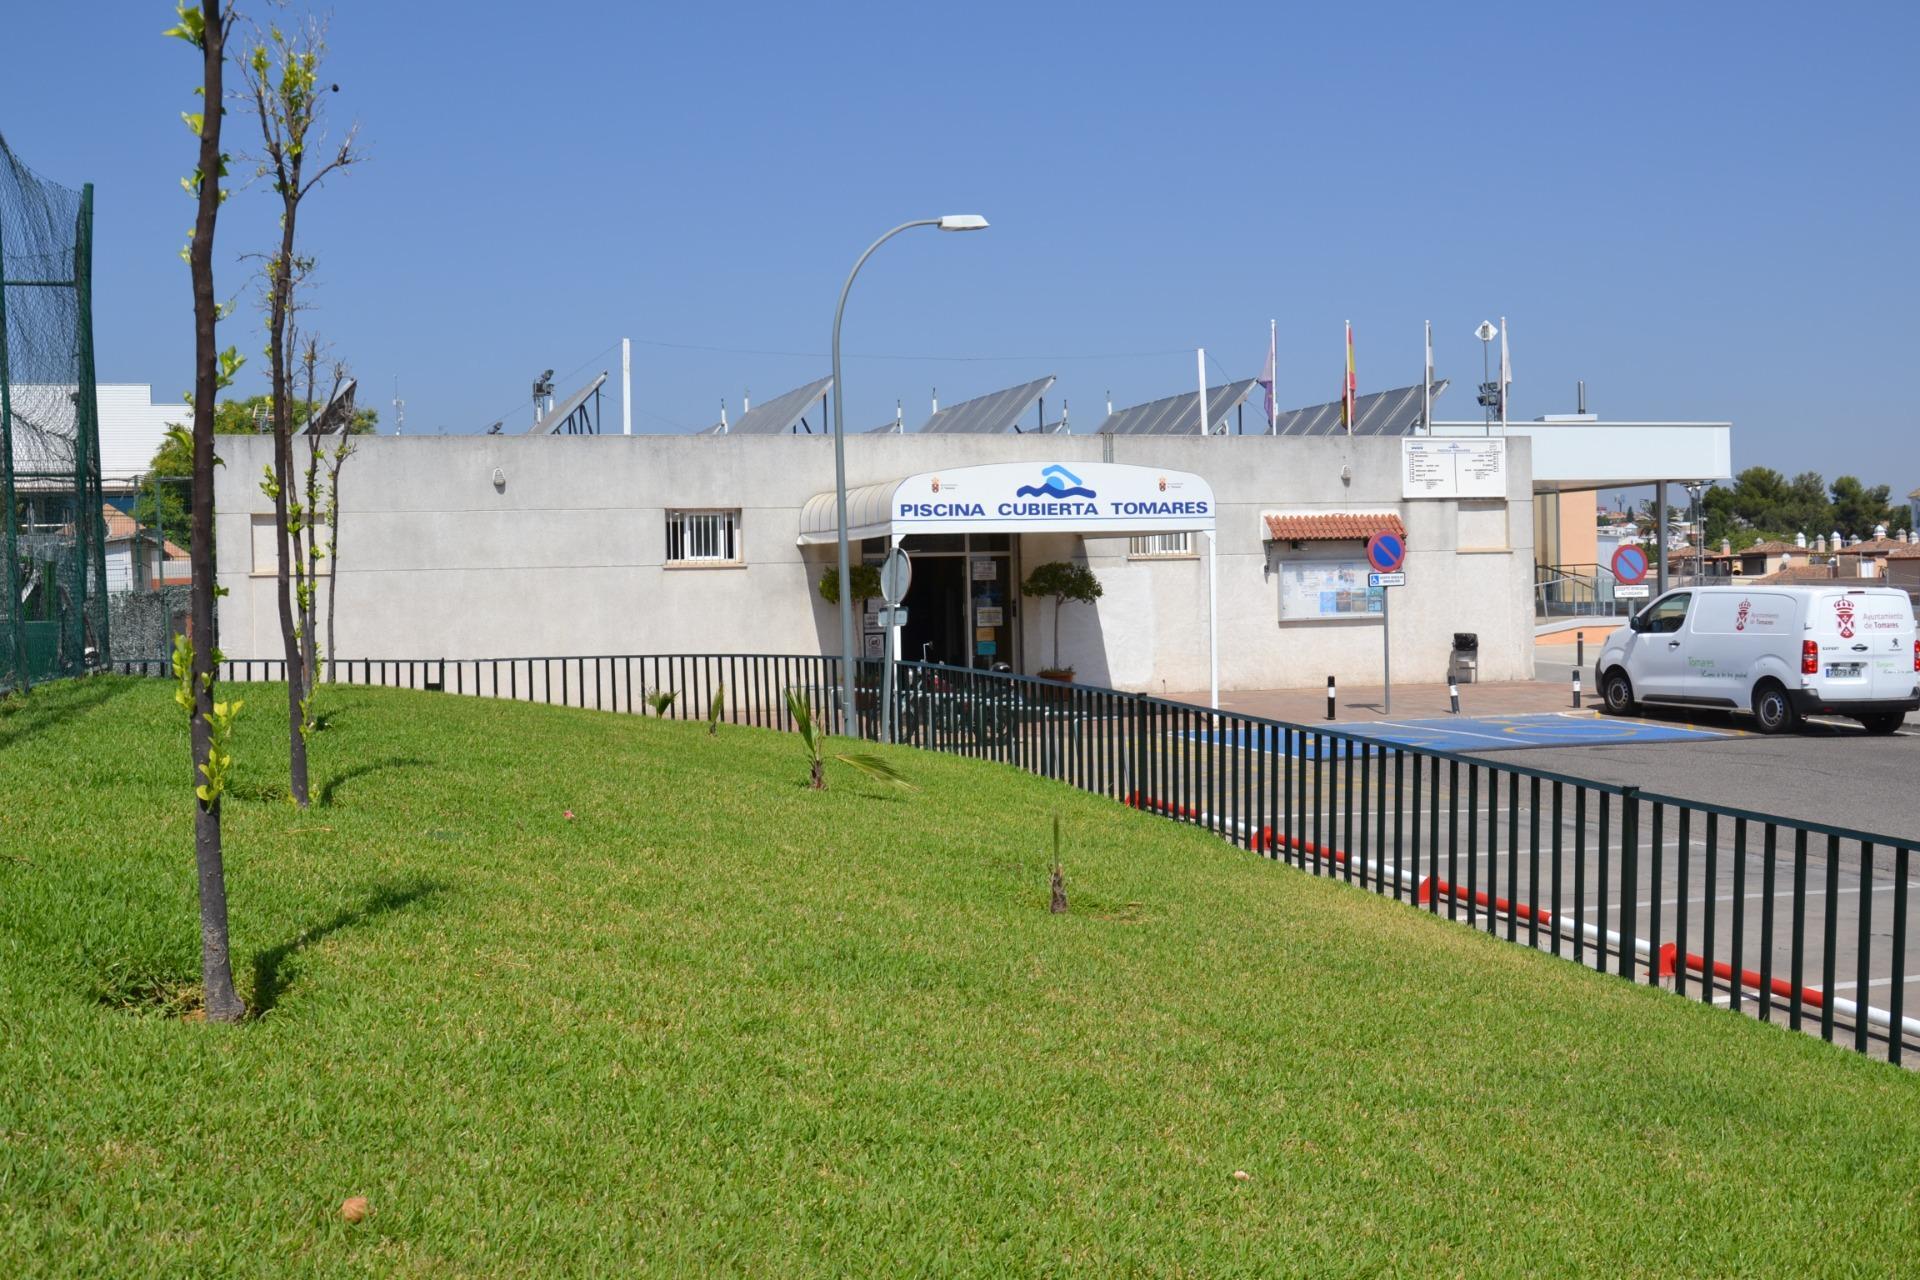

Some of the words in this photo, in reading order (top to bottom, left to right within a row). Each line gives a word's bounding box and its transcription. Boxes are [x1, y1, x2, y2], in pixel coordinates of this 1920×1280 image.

[901, 503, 986, 517] PISCINA
[998, 502, 1098, 516] CUBIERTA
[1112, 502, 1208, 515] TOMARES
[1863, 613, 1904, 621] Ayuntamiento
[1874, 621, 1899, 629] Tomares
[1688, 656, 1714, 667] Tomares
